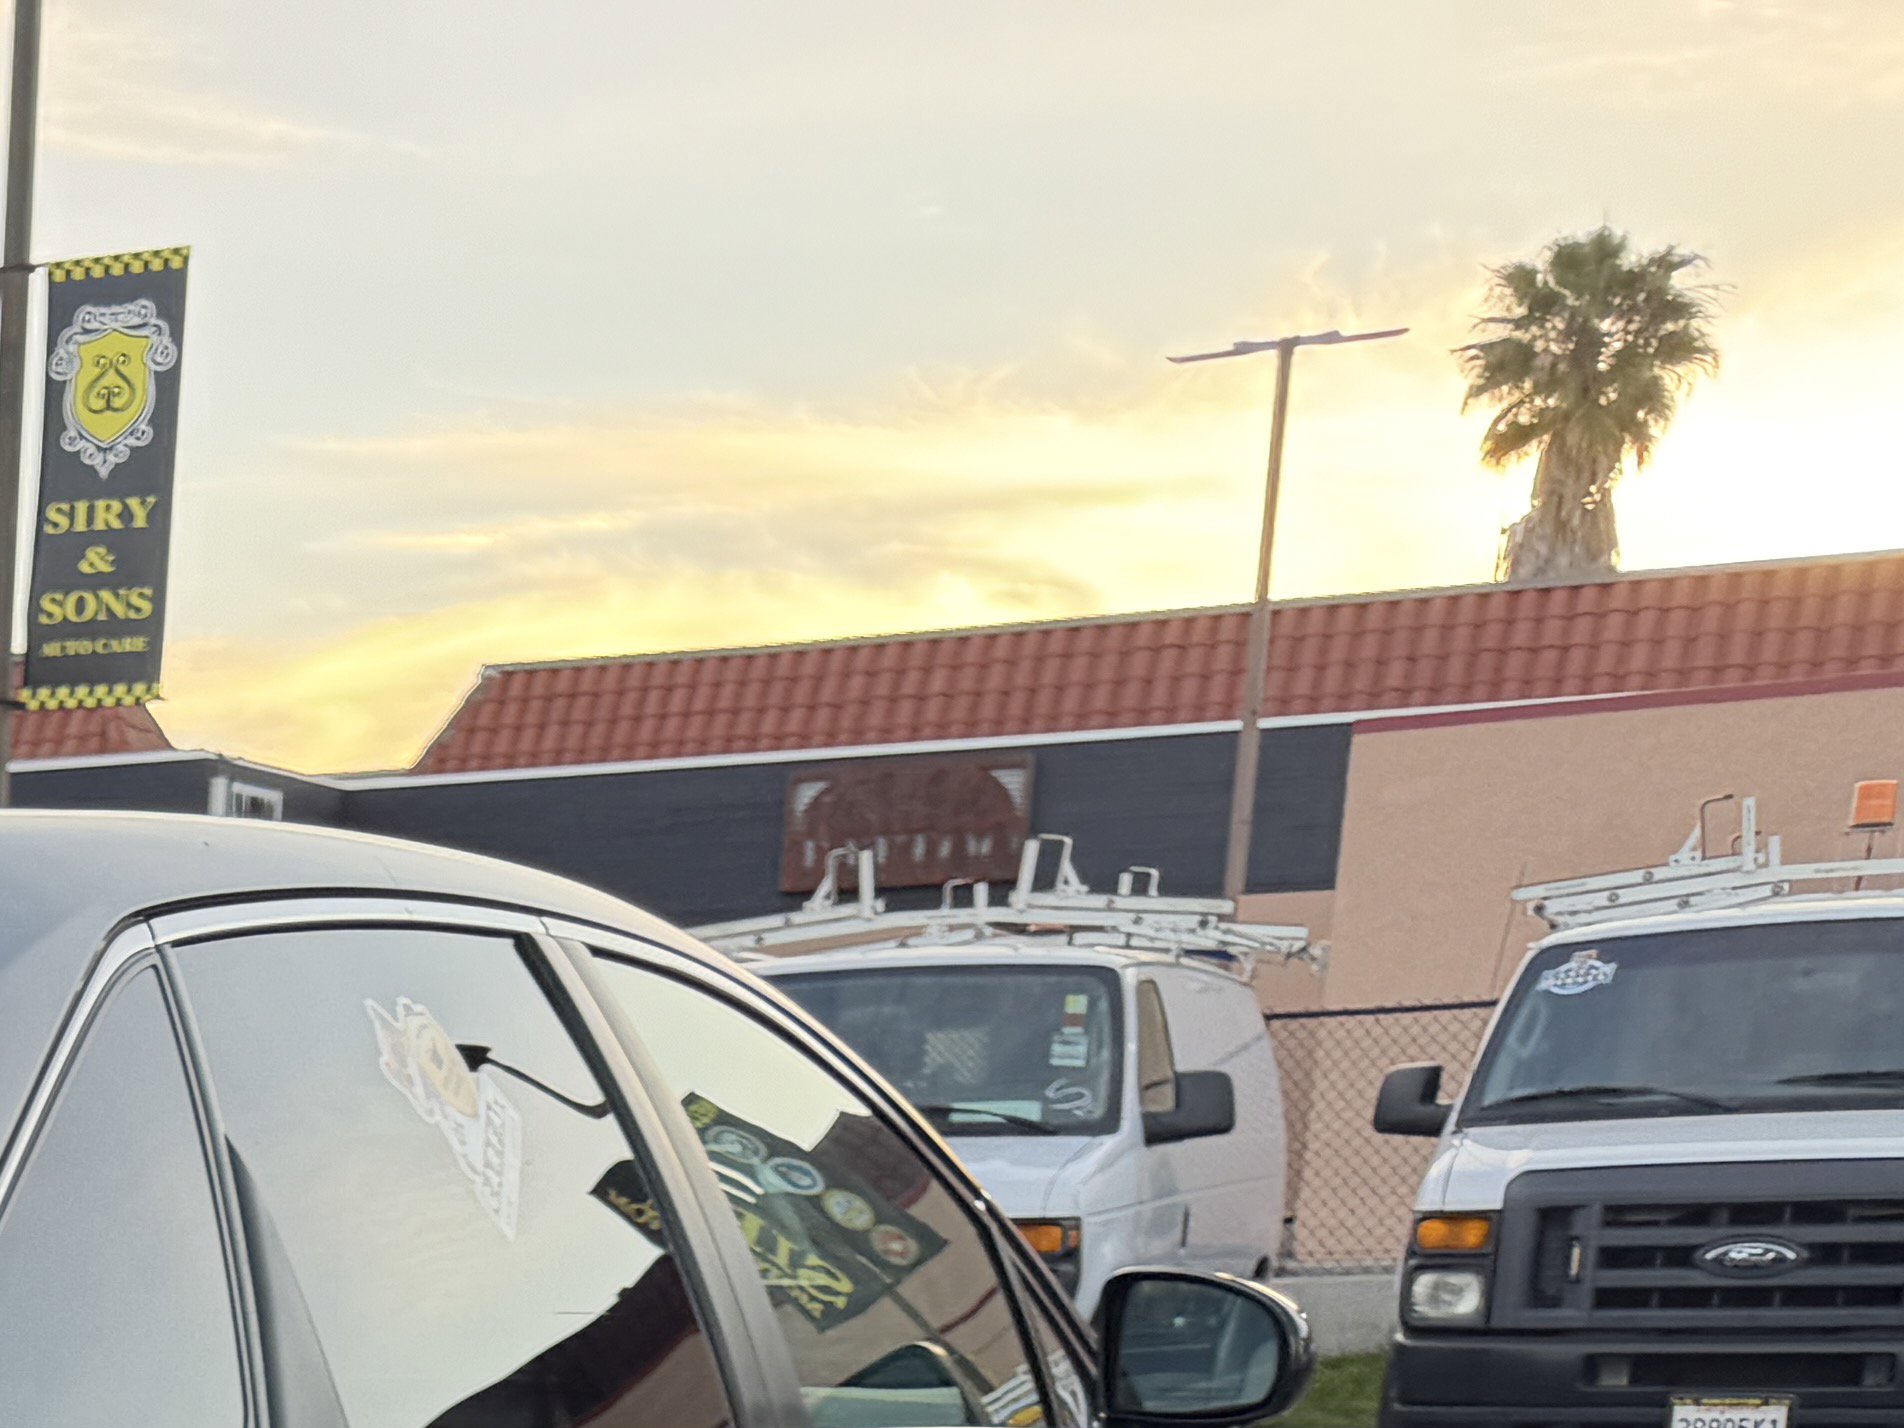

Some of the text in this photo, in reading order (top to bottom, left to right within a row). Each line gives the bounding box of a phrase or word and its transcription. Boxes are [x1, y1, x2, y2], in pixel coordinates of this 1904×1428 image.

[43, 496, 158, 535] SIRY
[77, 545, 117, 574] &
[38, 587, 153, 625] SONS
